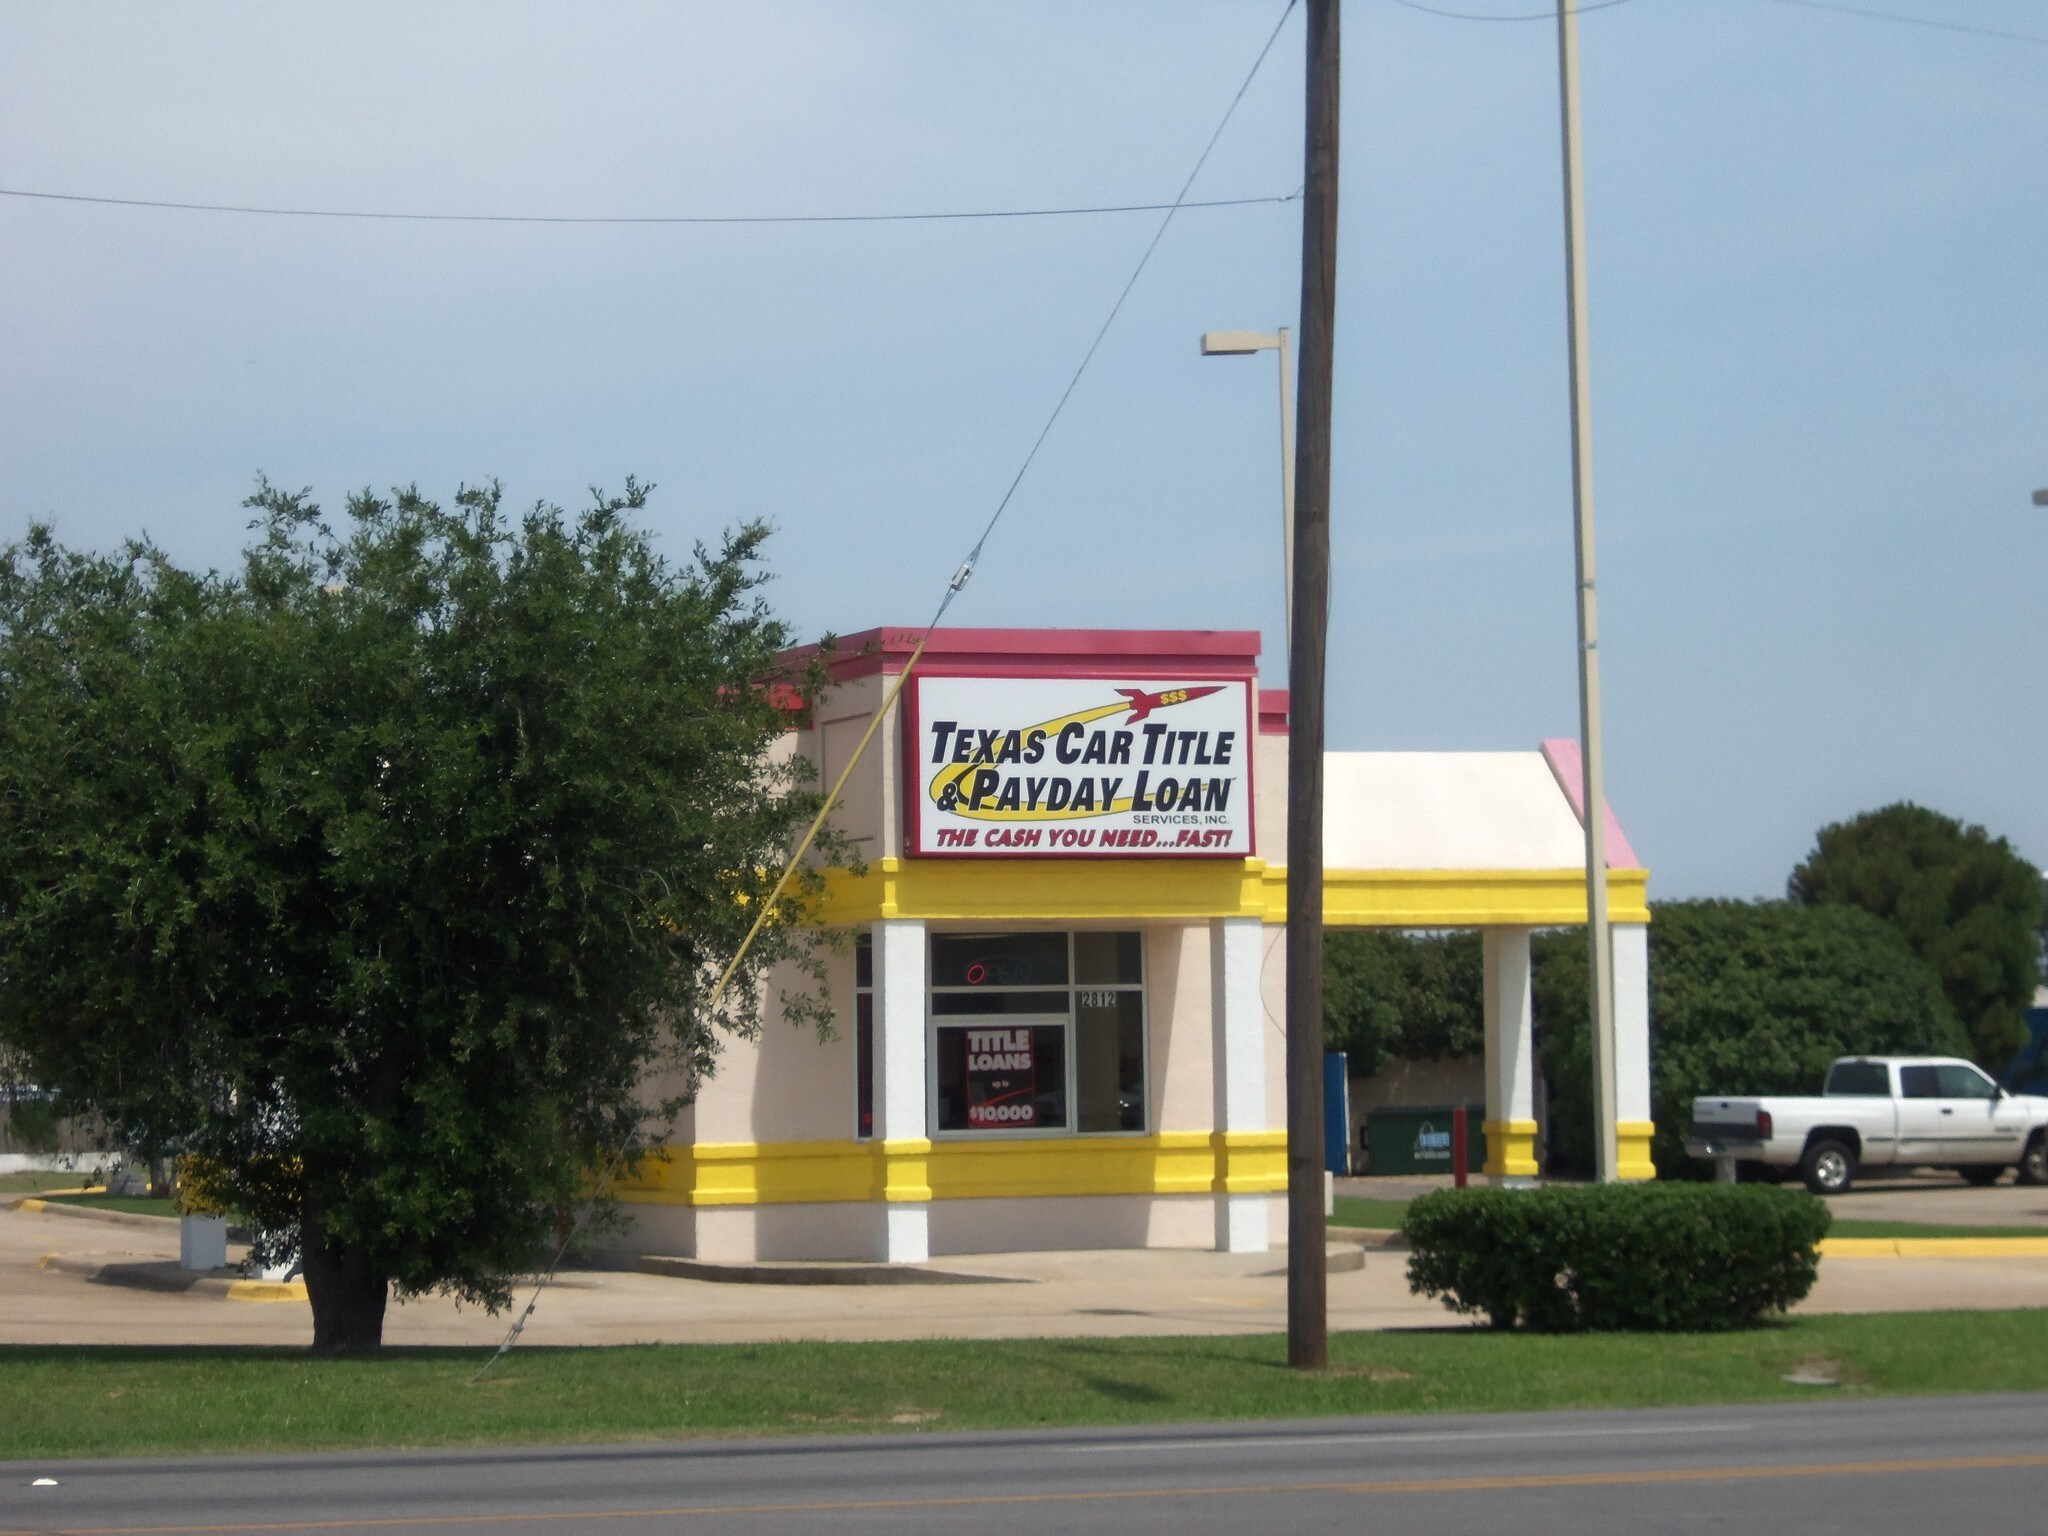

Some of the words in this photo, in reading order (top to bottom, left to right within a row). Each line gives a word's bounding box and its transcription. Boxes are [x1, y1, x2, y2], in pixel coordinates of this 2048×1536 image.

[931, 721, 1047, 764] TEXAS
[1055, 721, 1134, 765] CAR
[1142, 723, 1235, 765] TITLE
[936, 782, 959, 811] &
[968, 769, 1123, 812] PAYDAY
[1130, 770, 1232, 812] LOAN
[1133, 814, 1202, 825] SERVICES,
[1204, 815, 1230, 825] INC.
[937, 828, 978, 847] THE
[985, 828, 1046, 847] CASH
[1049, 829, 1098, 847] YOU
[1082, 991, 1116, 1007] 2812
[968, 1029, 1030, 1051] TITLE
[969, 1053, 1032, 1072] LOANS
[969, 1104, 1034, 1122] $10,000
